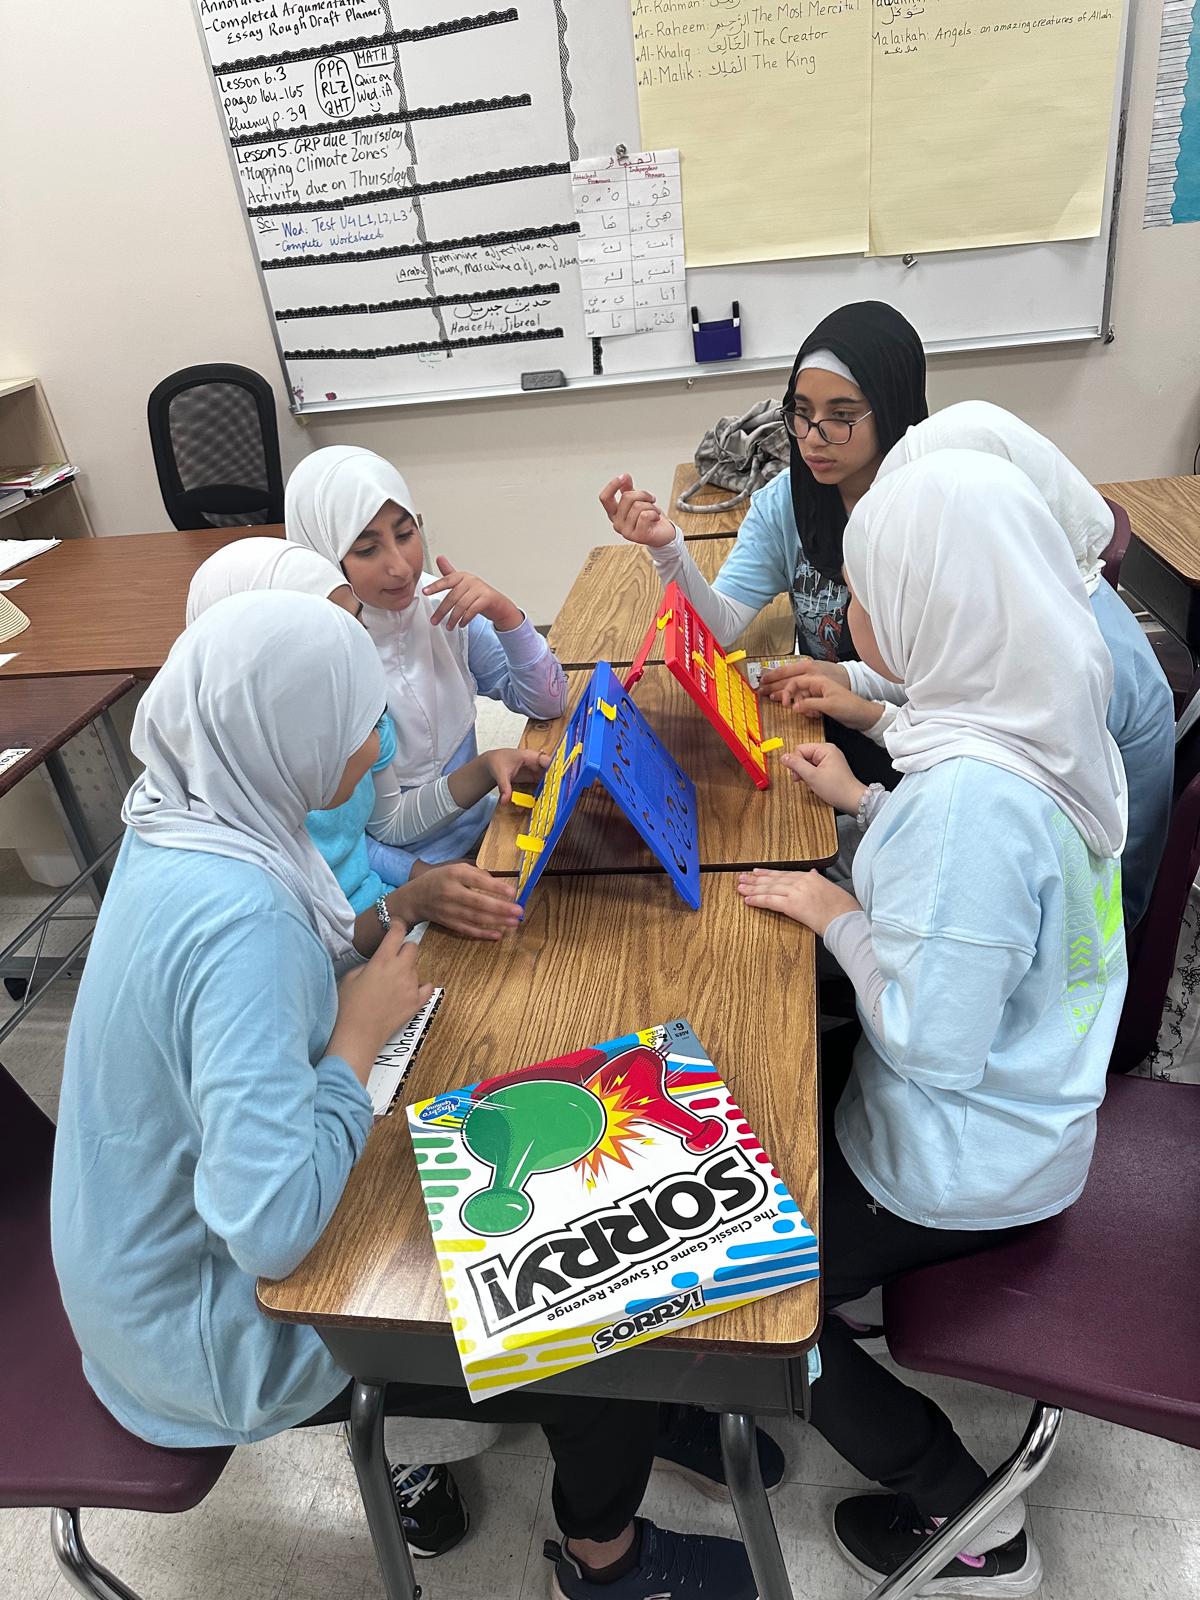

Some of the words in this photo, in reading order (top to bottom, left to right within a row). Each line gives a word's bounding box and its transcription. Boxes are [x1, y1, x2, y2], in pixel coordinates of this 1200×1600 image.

[751, 5, 772, 24] The
[777, 3, 803, 20] Most
[979, 25, 991, 34] an
[993, 20, 1031, 34] amazing
[1032, 15, 1074, 28] creatures
[1077, 11, 1087, 22] of
[1088, 9, 1113, 22] Allah
[227, 27, 264, 45] Essay
[269, 17, 307, 36] Rough
[310, 9, 341, 28] Draft
[345, 7, 382, 22] Planner
[753, 29, 776, 46] The
[780, 25, 829, 44] Creator
[357, 47, 387, 65] MATH
[752, 53, 778, 70] The
[786, 50, 817, 75] King
[264, 66, 287, 84] 6.3
[355, 73, 377, 87] Quiz
[223, 93, 258, 115] pages
[286, 103, 307, 122] 39
[324, 133, 349, 147] due
[351, 128, 404, 150] Thursday
[297, 149, 349, 172] Climate
[248, 182, 301, 205] Activity
[306, 179, 329, 196] due
[332, 179, 347, 191] on
[350, 166, 407, 188] Thursday
[312, 215, 337, 232] Test
[431, 250, 478, 267] Feminine
[537, 238, 559, 251] and
[539, 256, 558, 270] and
[400, 266, 427, 279] Arabic
[752, 1207, 780, 1223] The
[479, 1155, 758, 1322] SORRY!
[707, 1219, 754, 1244] Classic
[669, 1241, 710, 1263] Game
[649, 1259, 670, 1274] Of
[606, 1268, 651, 1294] Sweet
[546, 1290, 608, 1321] Revenge
[595, 1289, 702, 1350] SORRY!
